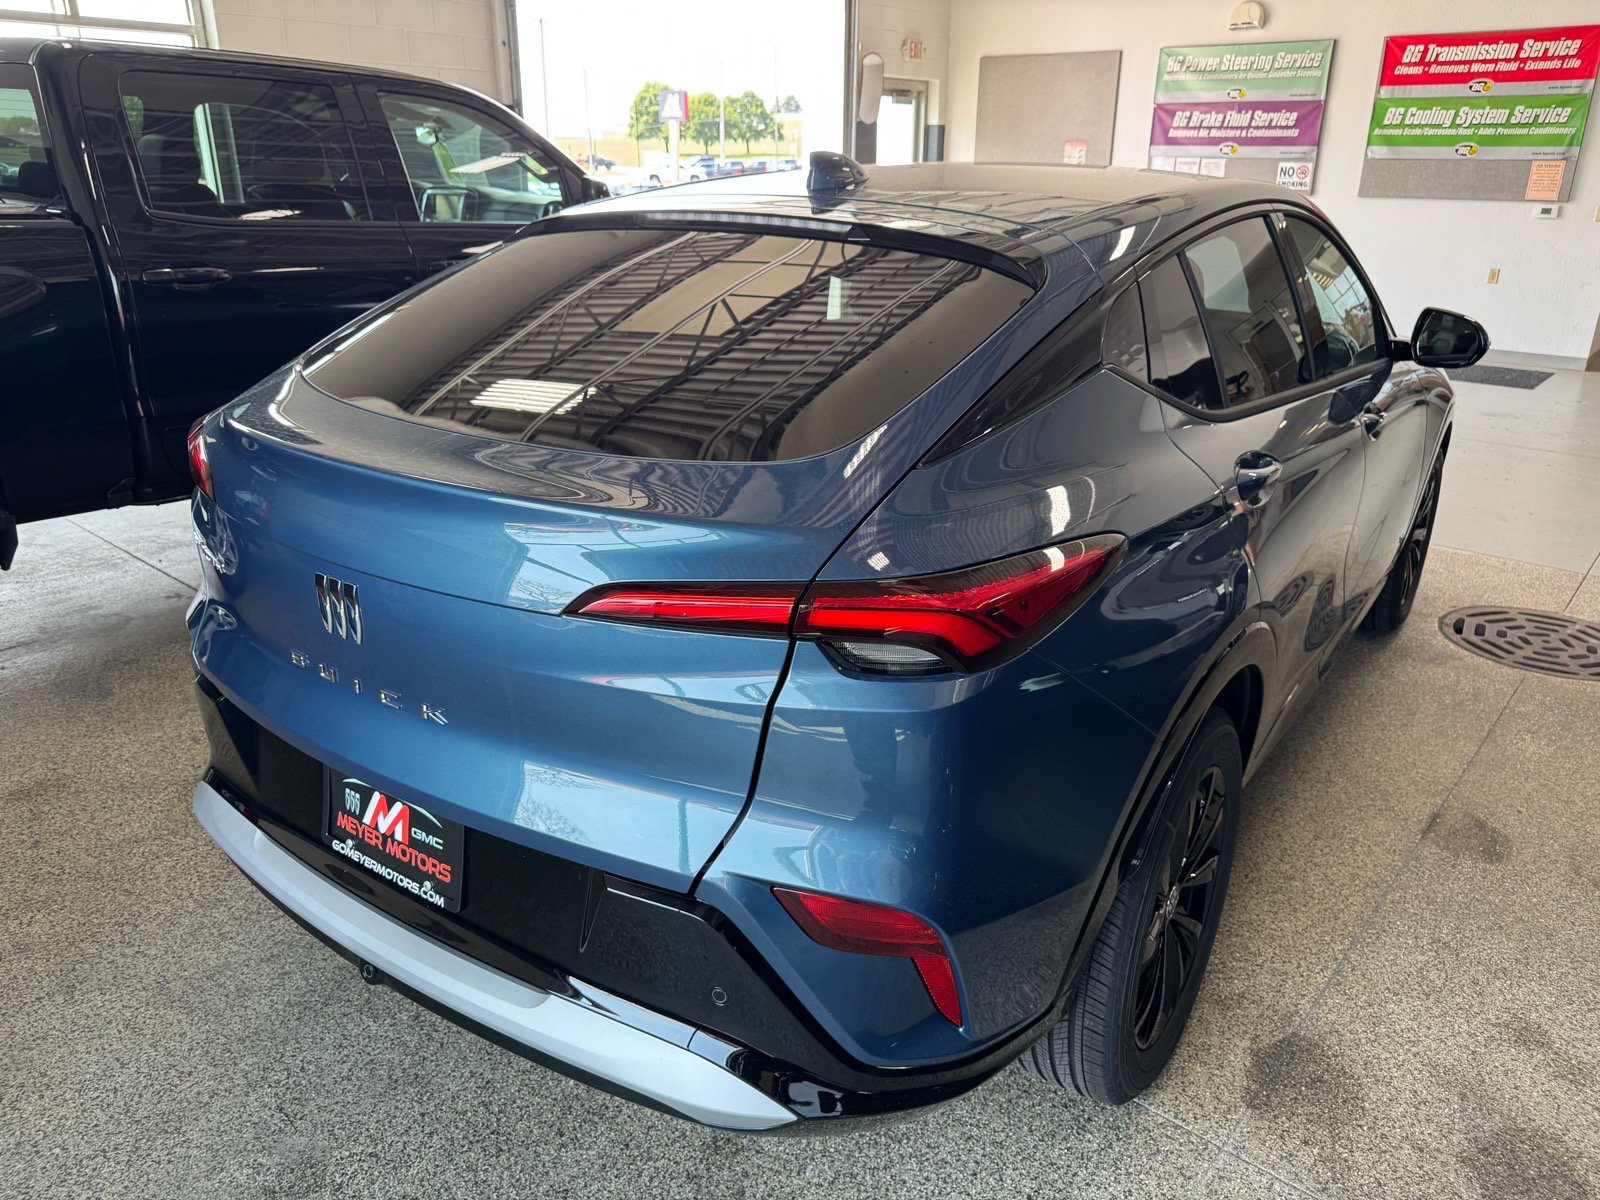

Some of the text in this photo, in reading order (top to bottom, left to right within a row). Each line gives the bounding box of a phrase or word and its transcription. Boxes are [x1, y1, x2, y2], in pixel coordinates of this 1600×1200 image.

[1166, 50, 1323, 73] BG Power Steering Service
[1401, 37, 1583, 63] BG Transmission Service
[1297, 70, 1323, 78] Steering
[1393, 57, 1582, 75] Cleans Removes Worn Fluid Extends Life
[1172, 109, 1298, 128] BG Brake Fluid Service
[1383, 104, 1573, 128] BG Cooling System Service
[1168, 128, 1199, 138] Removes
[1209, 128, 1241, 138] Moisture
[1247, 128, 1300, 138] Contaminants
[1374, 127, 1403, 136] Removes
[1477, 127, 1496, 136] Adds
[1496, 126, 1529, 135] Premium
[1529, 126, 1577, 135] Conditioners
[1279, 166, 1295, 177] NO
[289, 649, 449, 725] BUICK
[336, 810, 452, 884] MEYER MOTORS
[411, 826, 444, 851] GMC
[331, 839, 446, 909] GOMEYERMOTORS.COM
